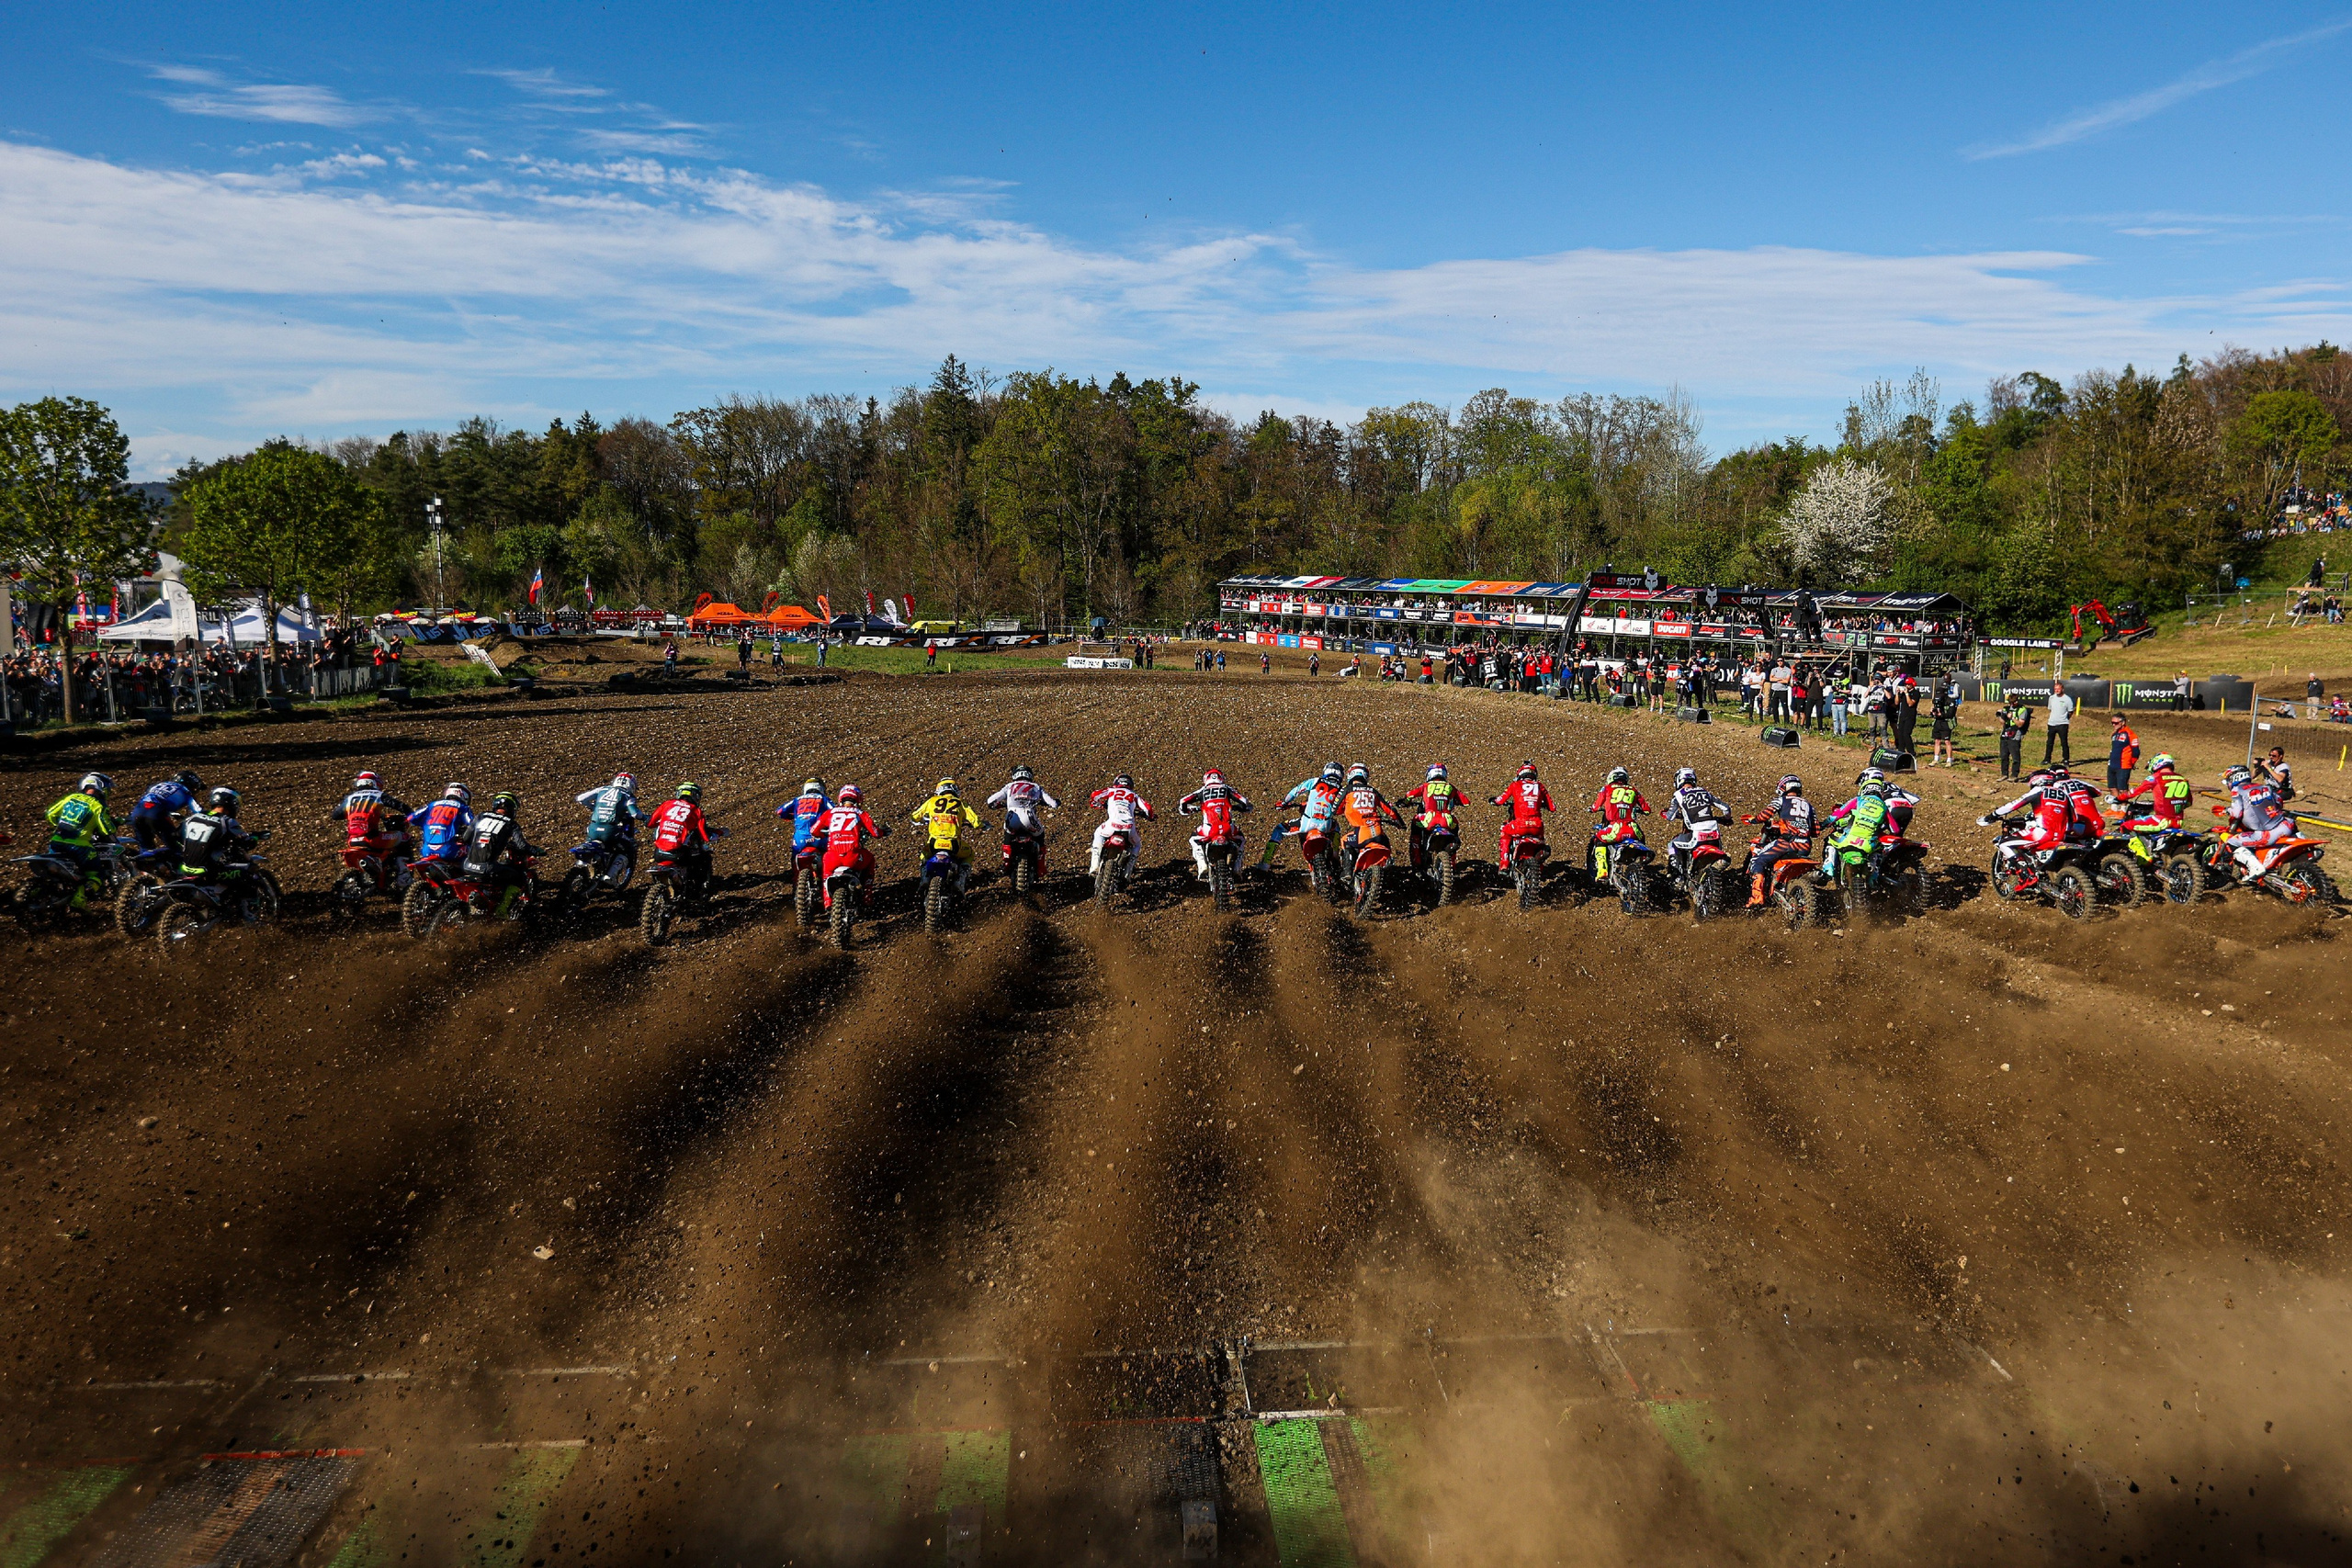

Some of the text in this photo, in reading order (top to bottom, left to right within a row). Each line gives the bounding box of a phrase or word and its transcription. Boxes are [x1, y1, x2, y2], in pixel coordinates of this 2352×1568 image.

[1592, 575, 1642, 586] HOLESHOT
[1720, 595, 1763, 605] HOLESHOT
[1657, 625, 1686, 634] DUCATI
[923, 636, 984, 647] RFX
[988, 635, 1046, 646] RFX
[1990, 638, 2025, 647] GOGGLE
[1484, 663, 1497, 674] 15
[1114, 790, 1135, 803] 24
[1203, 787, 1227, 803] 259
[1315, 783, 1339, 803] 96
[1521, 783, 1539, 796] 91
[1610, 787, 1635, 804] 93
[2042, 787, 2067, 802] 189
[2165, 781, 2188, 798] 10
[599, 788, 620, 807] 4
[1352, 791, 1376, 808] 253
[933, 797, 962, 815] 92
[1790, 798, 1810, 818] 39
[667, 806, 691, 822] 43
[830, 813, 859, 832] 87
